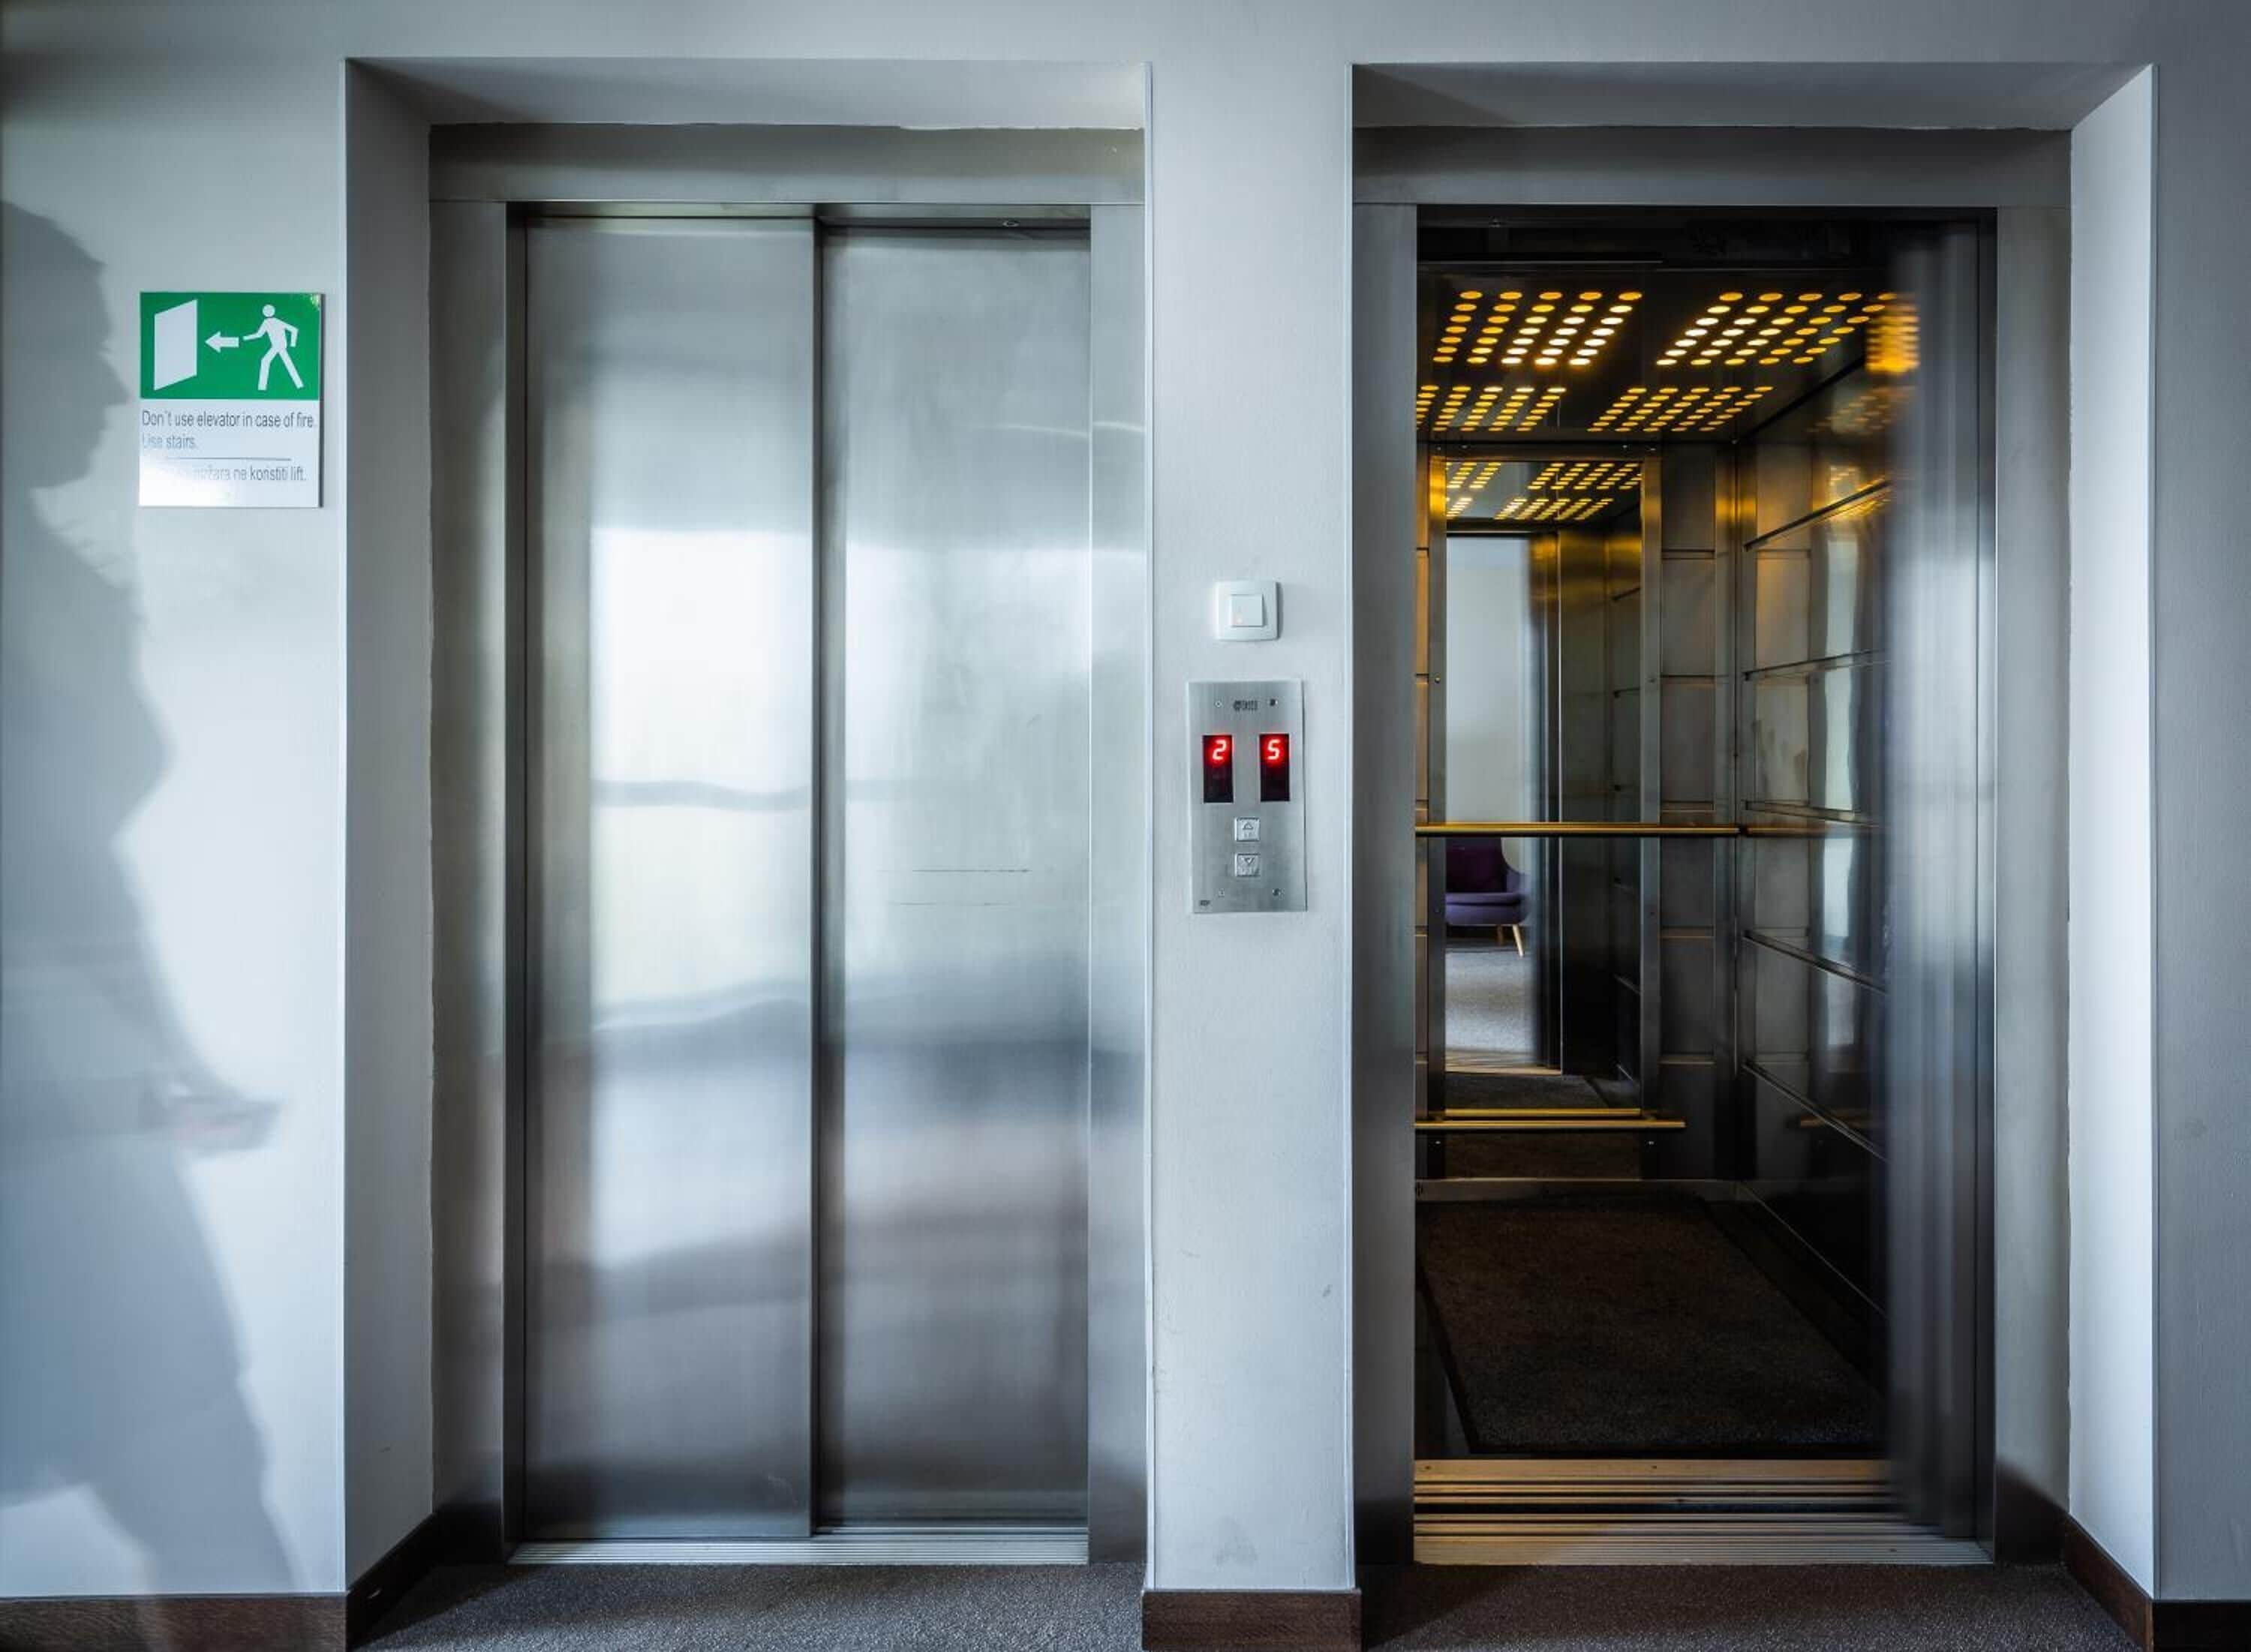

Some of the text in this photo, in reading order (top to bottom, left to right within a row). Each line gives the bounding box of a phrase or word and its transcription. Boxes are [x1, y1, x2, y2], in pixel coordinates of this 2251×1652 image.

[175, 414, 194, 427] use
[197, 410, 240, 428] elevator
[242, 412, 254, 428] in
[255, 415, 281, 428] case
[284, 412, 295, 428] of
[143, 433, 163, 449] Use
[233, 467, 248, 481] ne
[290, 465, 307, 481] lift.
[1212, 738, 1228, 760] 2
[1266, 738, 1282, 760] 5
